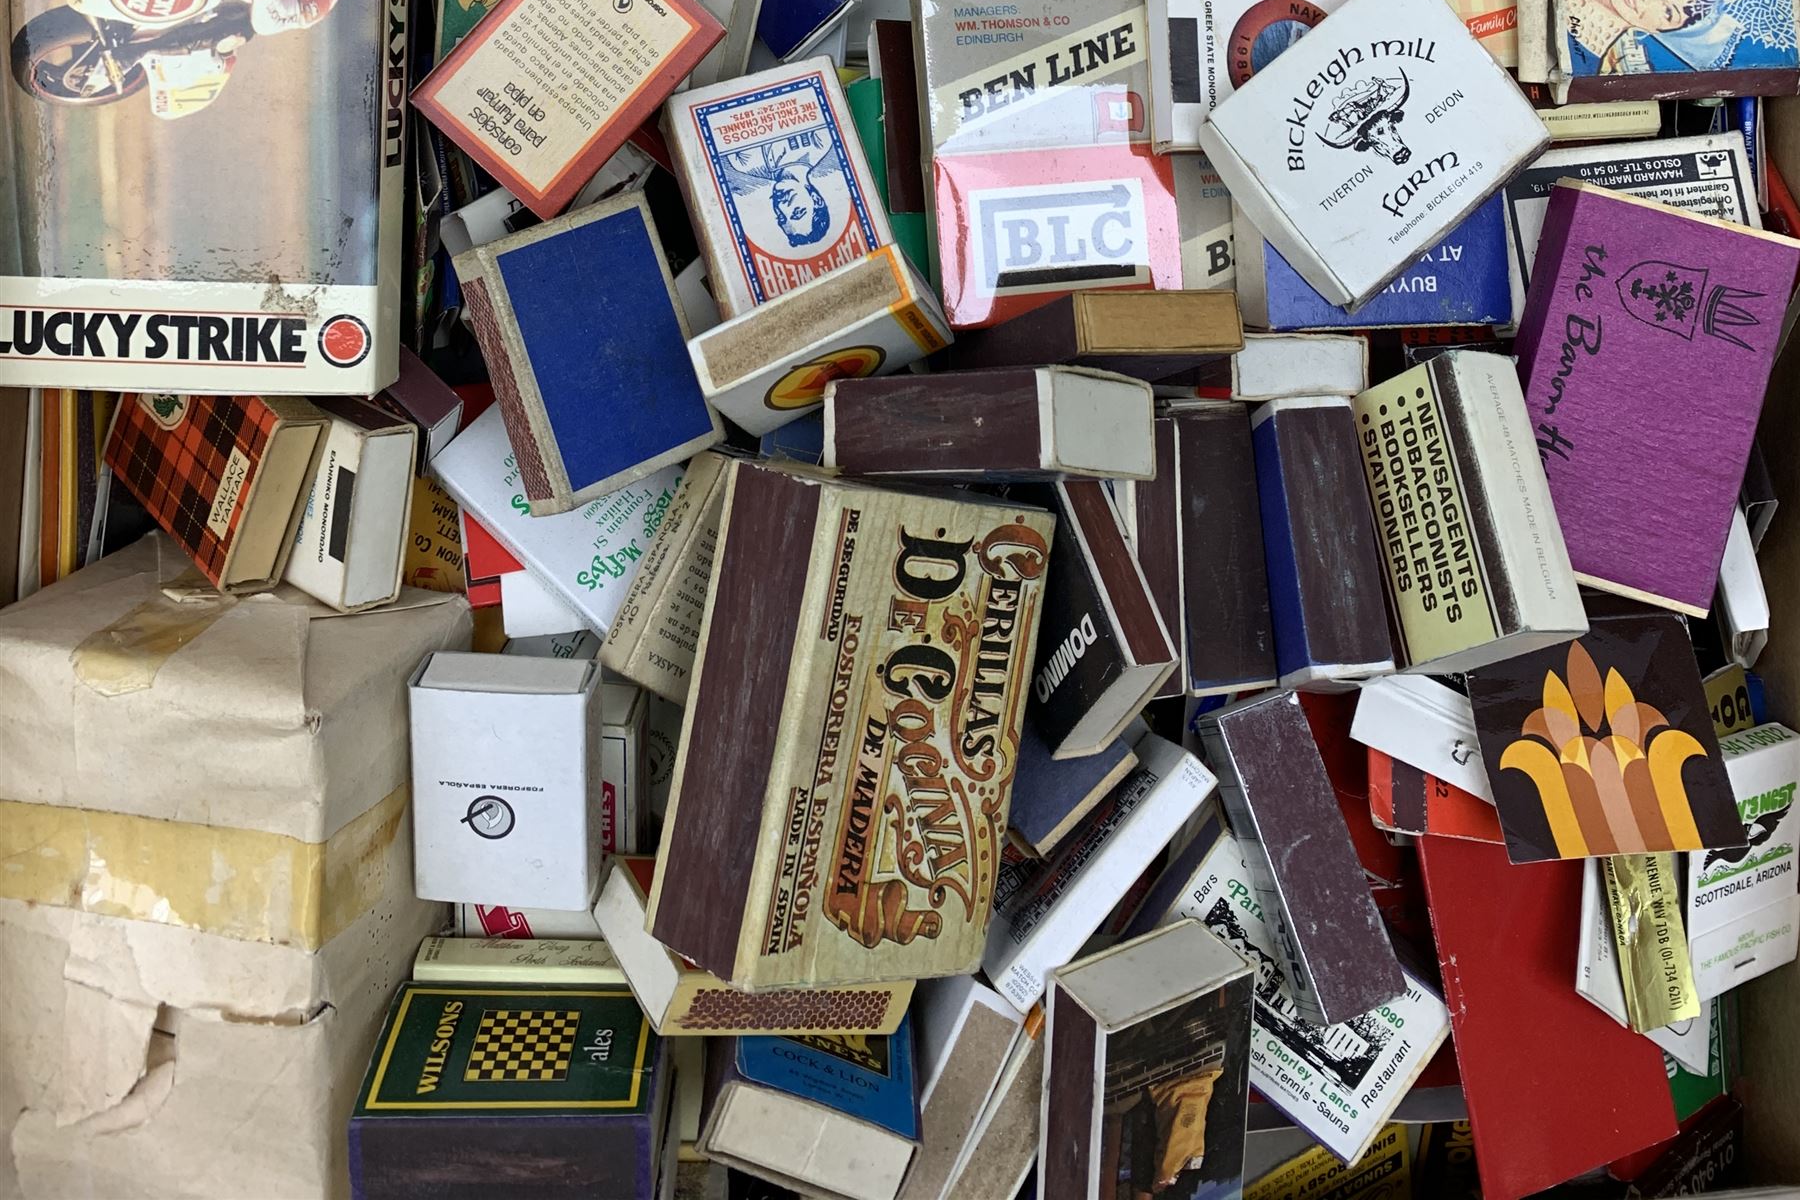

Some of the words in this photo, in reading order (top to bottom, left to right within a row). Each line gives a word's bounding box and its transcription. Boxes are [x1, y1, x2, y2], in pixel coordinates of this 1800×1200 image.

[1205, 0, 1213, 29] GREEK
[1469, 14, 1504, 35] Family
[956, 32, 1024, 46] EDINBURGH
[1206, 31, 1214, 65] STATE
[386, 14, 405, 168] LUCKY
[503, 79, 532, 107] pipa
[959, 63, 1037, 122] BEN
[1045, 23, 1136, 86] LINE
[475, 86, 516, 125] fumar
[527, 103, 547, 122] en
[713, 118, 760, 136] CHANNEL.
[759, 106, 798, 124] ENGLISH
[777, 111, 818, 129] SWAM
[799, 100, 818, 114] THE
[1424, 89, 1465, 125] DEVON
[467, 106, 523, 157] consejos
[515, 118, 548, 148] para
[722, 122, 775, 144] ACROSS
[1581, 168, 1592, 178] 10
[1594, 166, 1606, 176] 54
[1608, 164, 1619, 175] 10
[1619, 162, 1642, 174] TLF.
[1652, 157, 1682, 170] OSLO
[1319, 165, 1374, 212] TIVERTON
[1388, 210, 1428, 245] Telephone:
[1426, 174, 1468, 212] BICKLEIGH
[1467, 161, 1484, 178] 419
[1002, 210, 1134, 266] BLC
[1439, 245, 1463, 262] AT
[145, 313, 307, 363] STRIKE
[210, 454, 241, 524] WALLACE
[219, 466, 246, 525] TARTAN
[595, 490, 633, 528] Halifax
[1363, 428, 1412, 593] STATIONERS
[1416, 401, 1478, 598] NEWSAGENTS
[845, 507, 861, 535] DE
[1380, 419, 1438, 612] BOOKSELLERS
[1399, 412, 1463, 624] TOBACCONISTS
[827, 537, 858, 642] SEGURIDAD
[888, 522, 976, 636] DE
[961, 520, 1050, 764] CERILLAS
[1034, 612, 1098, 704] DOMINO
[648, 651, 687, 679] ALASKA
[815, 613, 864, 787] FOSFORERA
[868, 714, 888, 759] DE
[1720, 725, 1794, 756] 941-0602
[880, 643, 972, 885] COCINA
[490, 784, 544, 792] FOSFORERA
[786, 786, 809, 846] MADE
[836, 763, 881, 898] MADERA
[782, 851, 802, 879] IN
[786, 795, 829, 953] ESPAÑOLA
[1694, 876, 1756, 909] SCOTTSDALE,
[1755, 860, 1792, 883] ARIZONA
[1193, 873, 1218, 904] Bars
[767, 886, 793, 956] SPAIN
[416, 1001, 464, 1095] WILSONS
[583, 1029, 614, 1063] ales
[1265, 1039, 1314, 1086] Chorley,
[1319, 1082, 1359, 1121] Lancs
[1360, 1039, 1413, 1109] Restaurant
[1274, 1066, 1311, 1102] Tennis
[1316, 1101, 1351, 1135] Sauna
